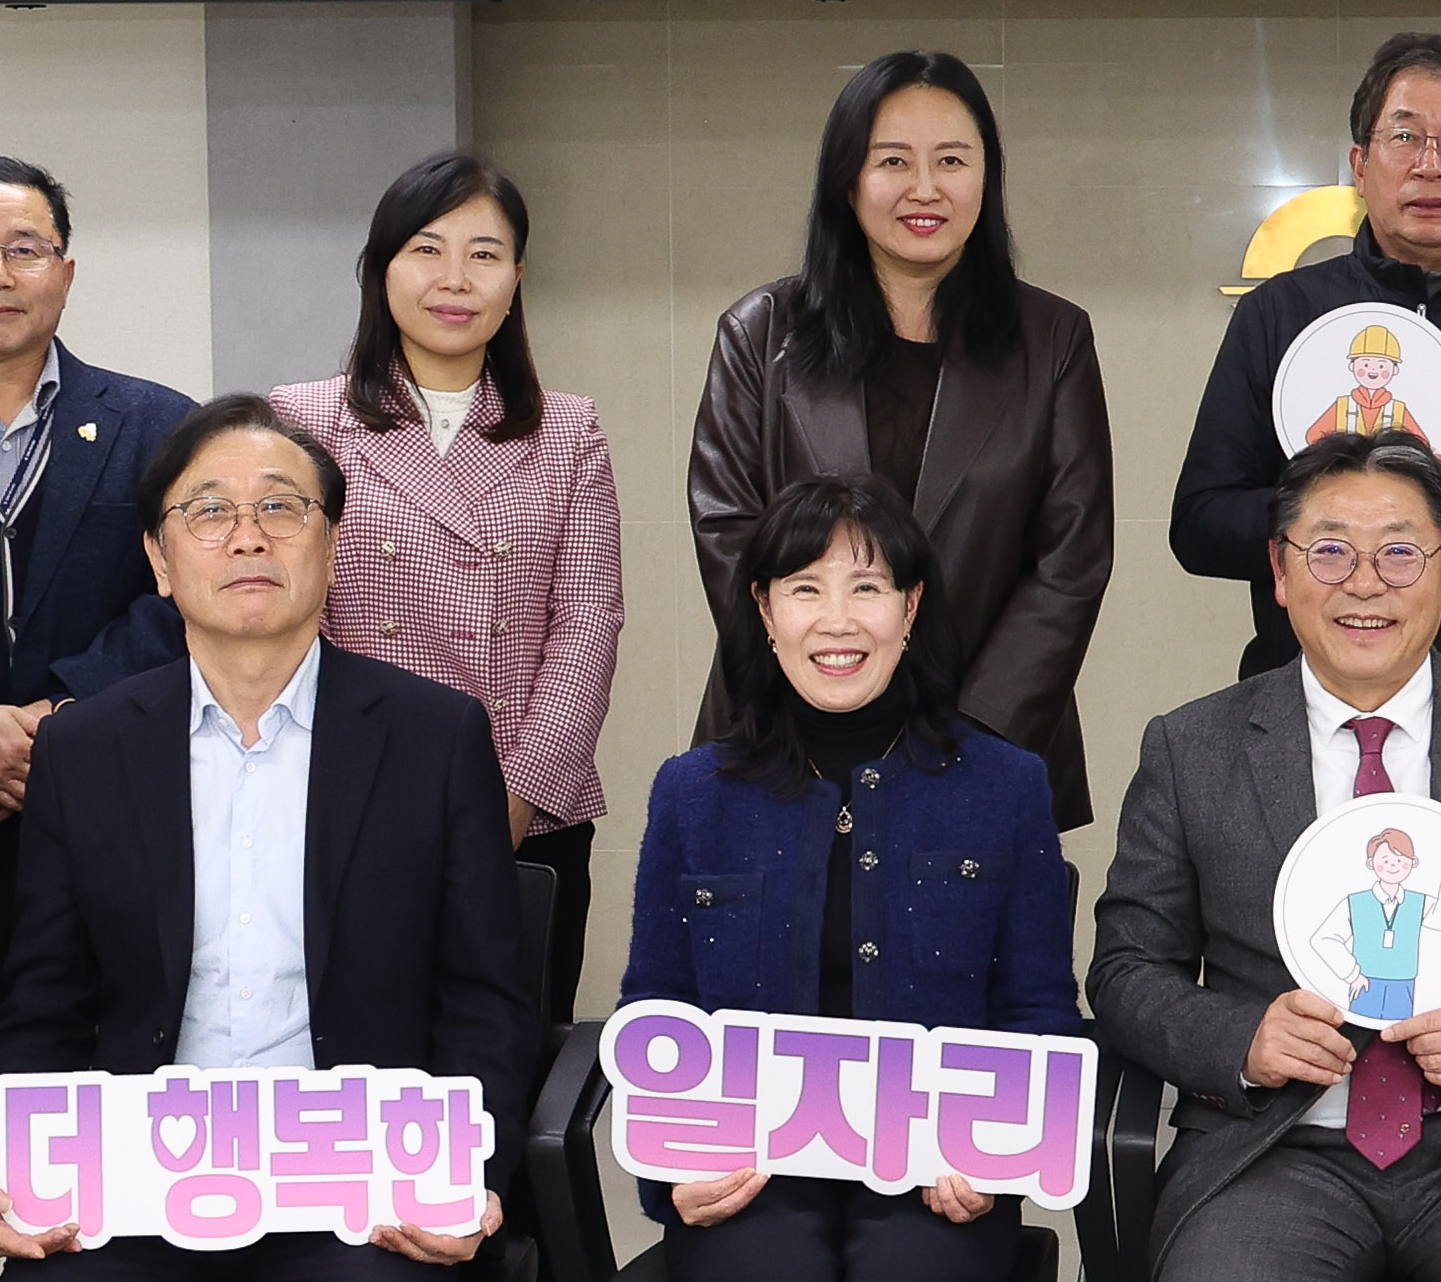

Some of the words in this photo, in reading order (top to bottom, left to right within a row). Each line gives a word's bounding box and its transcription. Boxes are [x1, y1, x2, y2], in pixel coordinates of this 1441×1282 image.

[5, 1084, 102, 1230] 더
[147, 1077, 483, 1240] 행복한
[614, 1013, 1085, 1197] 일자리
